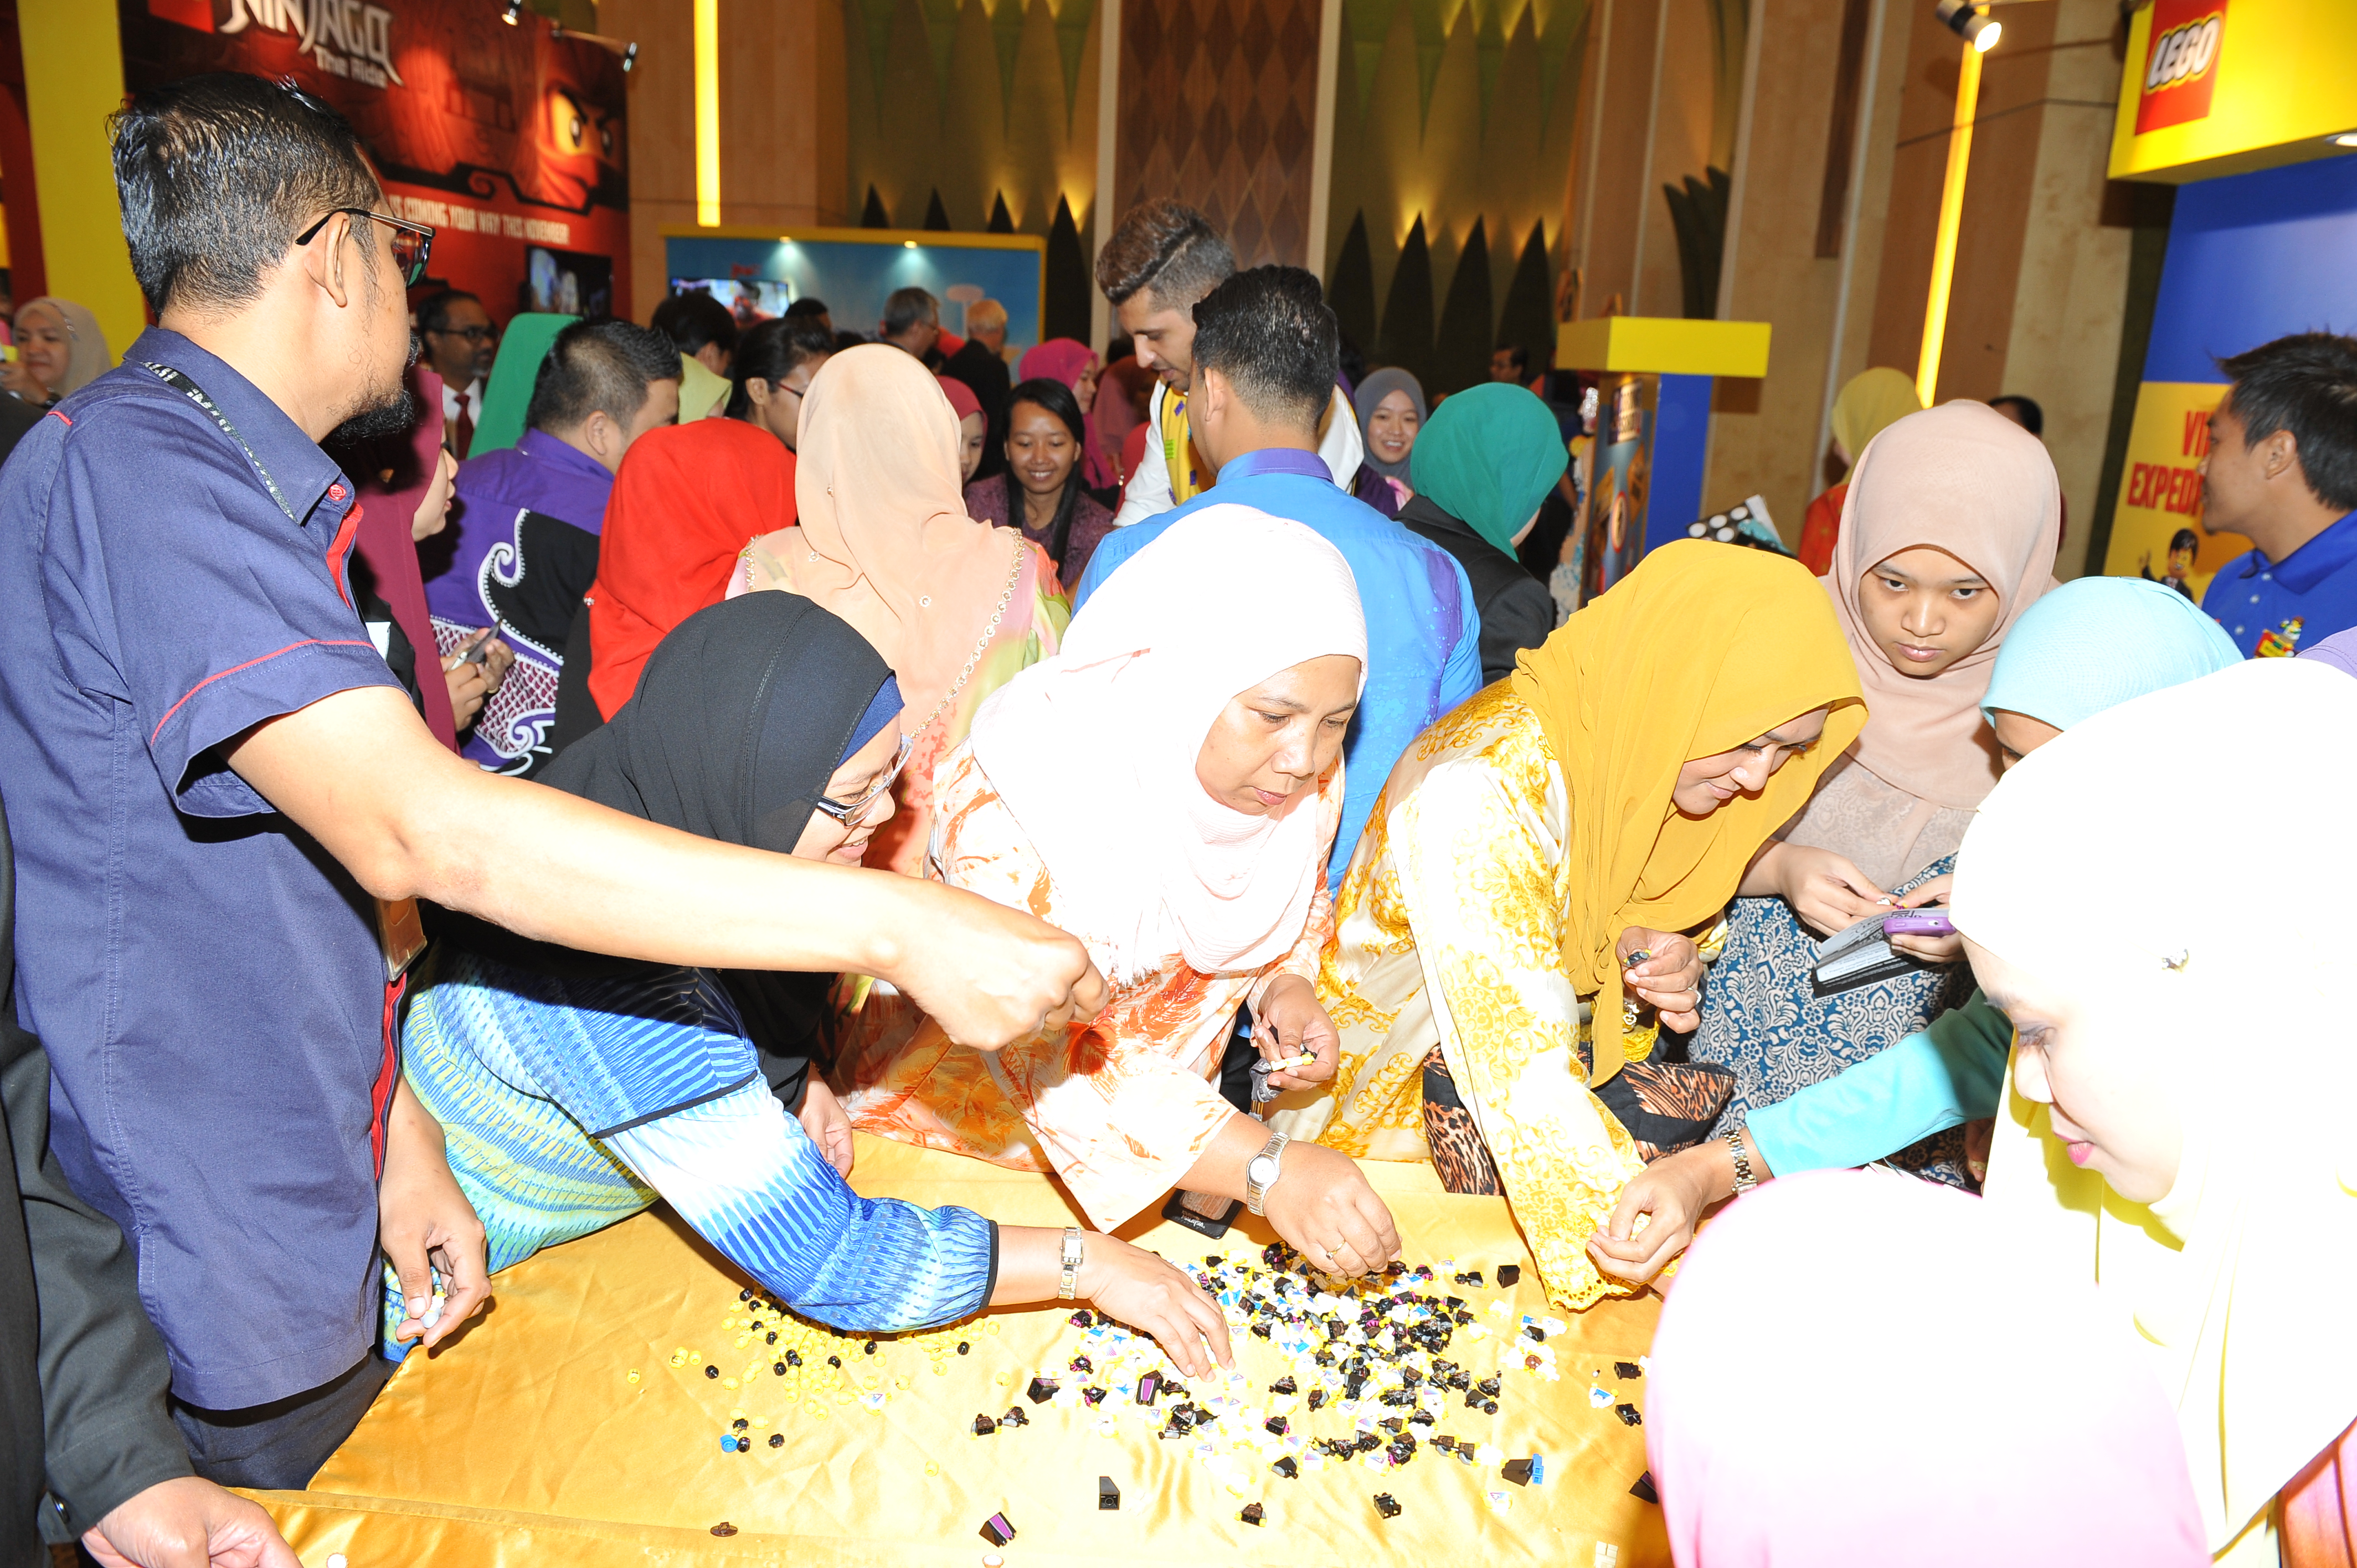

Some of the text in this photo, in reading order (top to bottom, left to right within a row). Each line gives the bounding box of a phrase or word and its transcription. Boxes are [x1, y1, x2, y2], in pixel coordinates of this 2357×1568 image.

[2145, 14, 2222, 91] LEGO
[404, 197, 449, 228] COMING
[449, 204, 476, 232] YOUR
[525, 218, 570, 245] NOVEMBER
